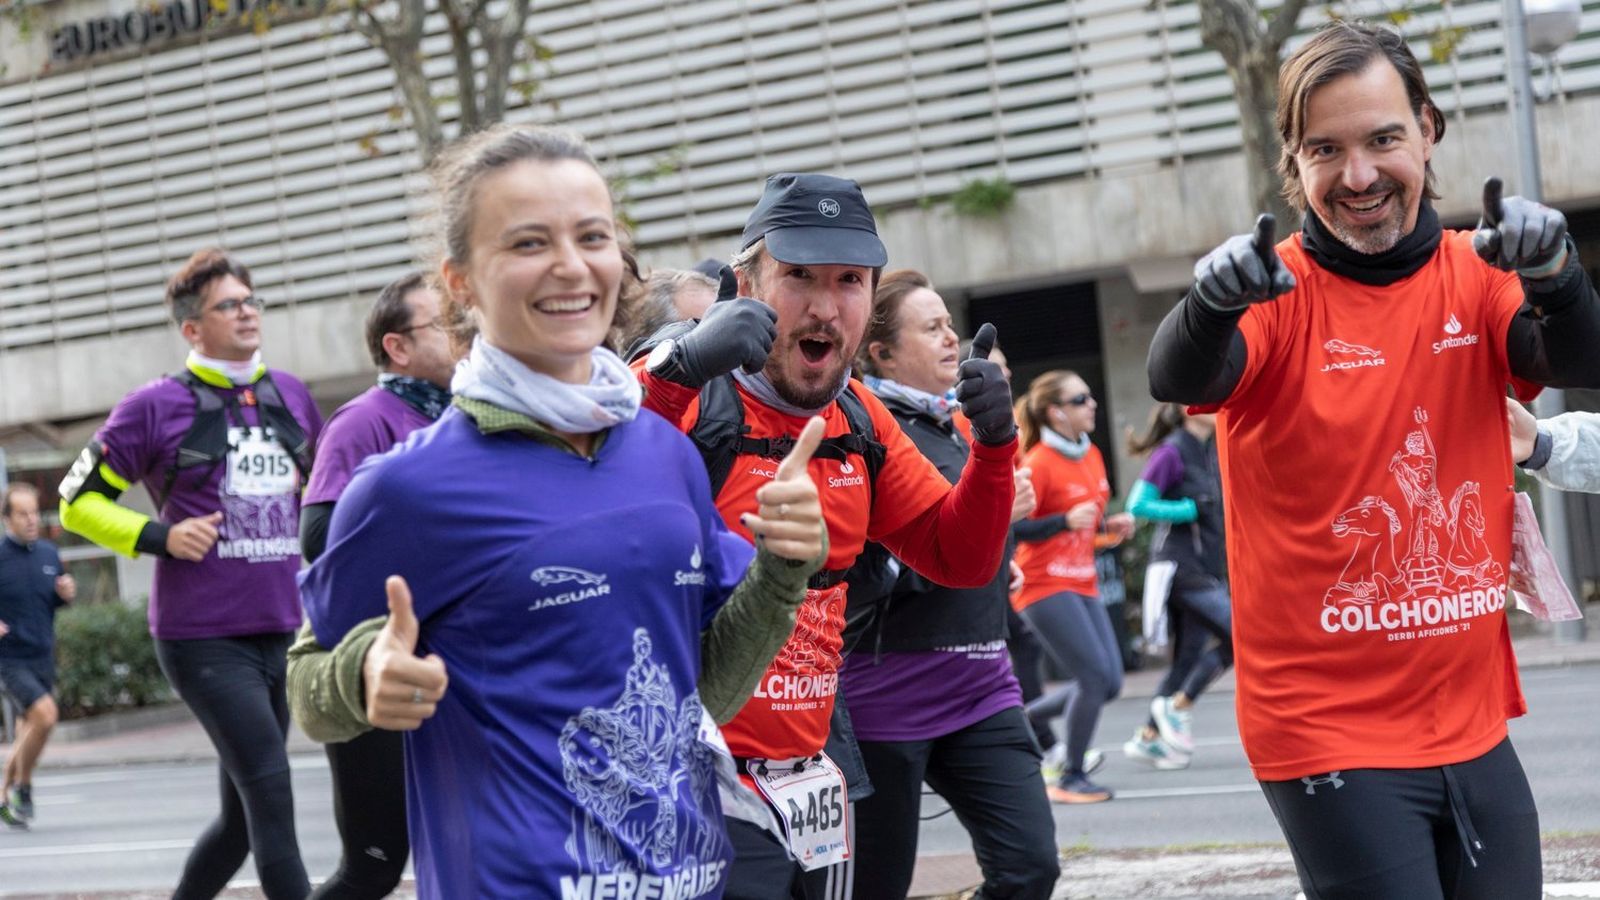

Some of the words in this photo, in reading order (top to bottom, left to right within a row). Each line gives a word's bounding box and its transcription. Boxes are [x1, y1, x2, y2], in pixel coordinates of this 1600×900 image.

[821, 201, 838, 214] Buff
[1321, 358, 1386, 372] JAGUAR
[237, 453, 290, 476] 4915
[749, 467, 777, 479] JAG
[828, 475, 864, 488] Santandr
[217, 536, 301, 560] MERENGUE
[528, 584, 611, 611] JAGUAR
[1320, 584, 1506, 633] COLCHONEROS
[1388, 631, 1415, 642] DERBI
[1418, 625, 1459, 639] AFICIONES
[753, 673, 839, 699] LCHONER
[787, 785, 843, 836] 4465
